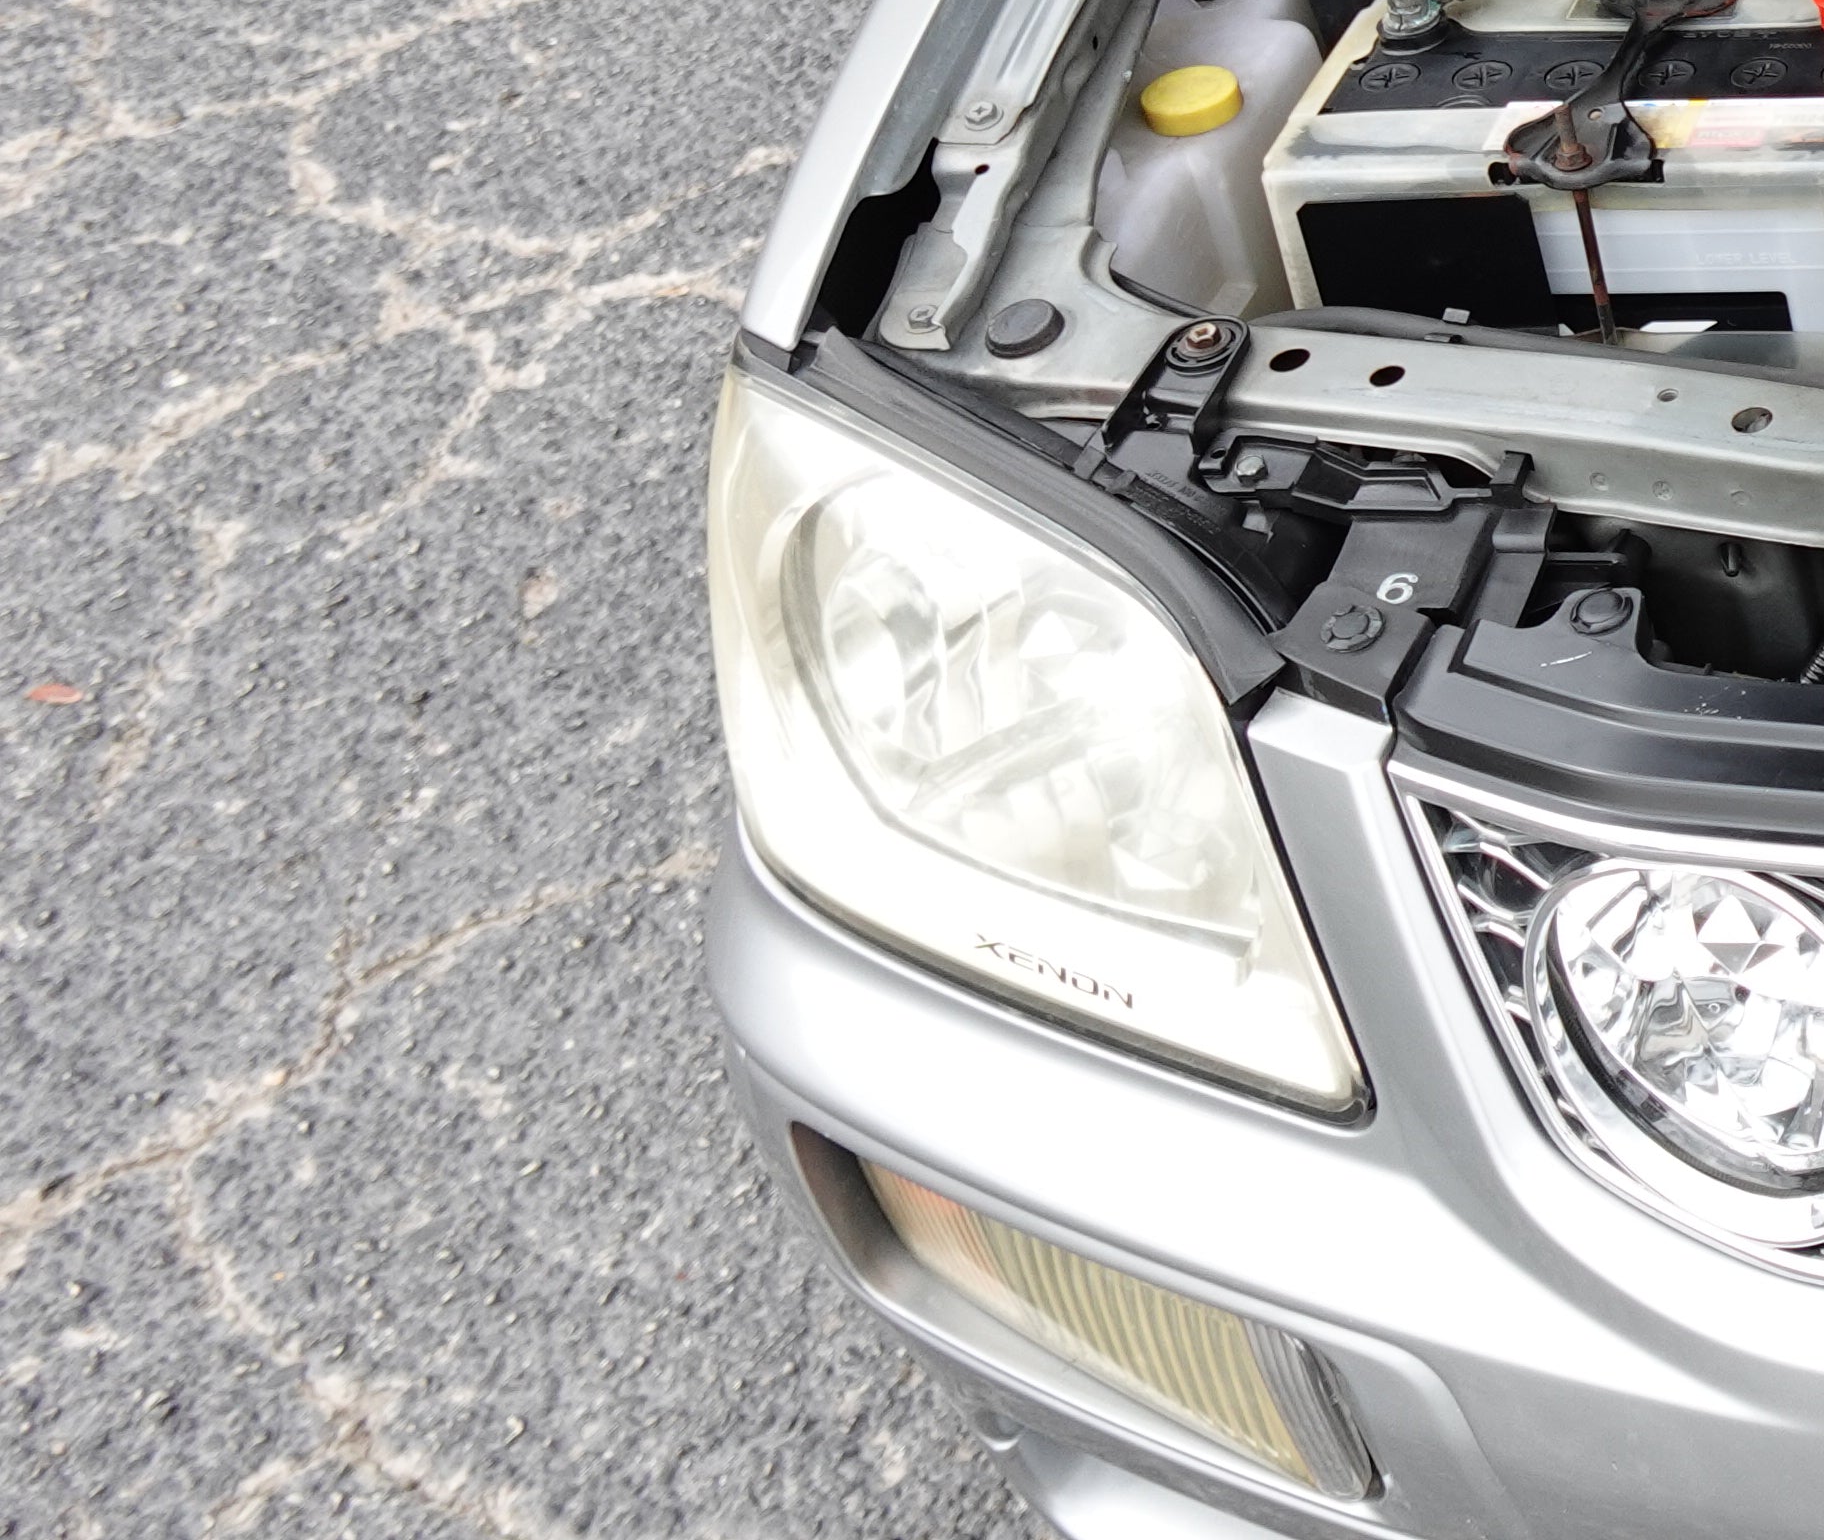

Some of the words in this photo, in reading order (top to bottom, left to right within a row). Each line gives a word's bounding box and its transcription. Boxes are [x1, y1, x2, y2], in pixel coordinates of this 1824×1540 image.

[1695, 251, 1740, 265] LOWER
[1750, 251, 1792, 264] LEVEL
[1376, 572, 1418, 604] 6
[974, 933, 1133, 1009] XENON
